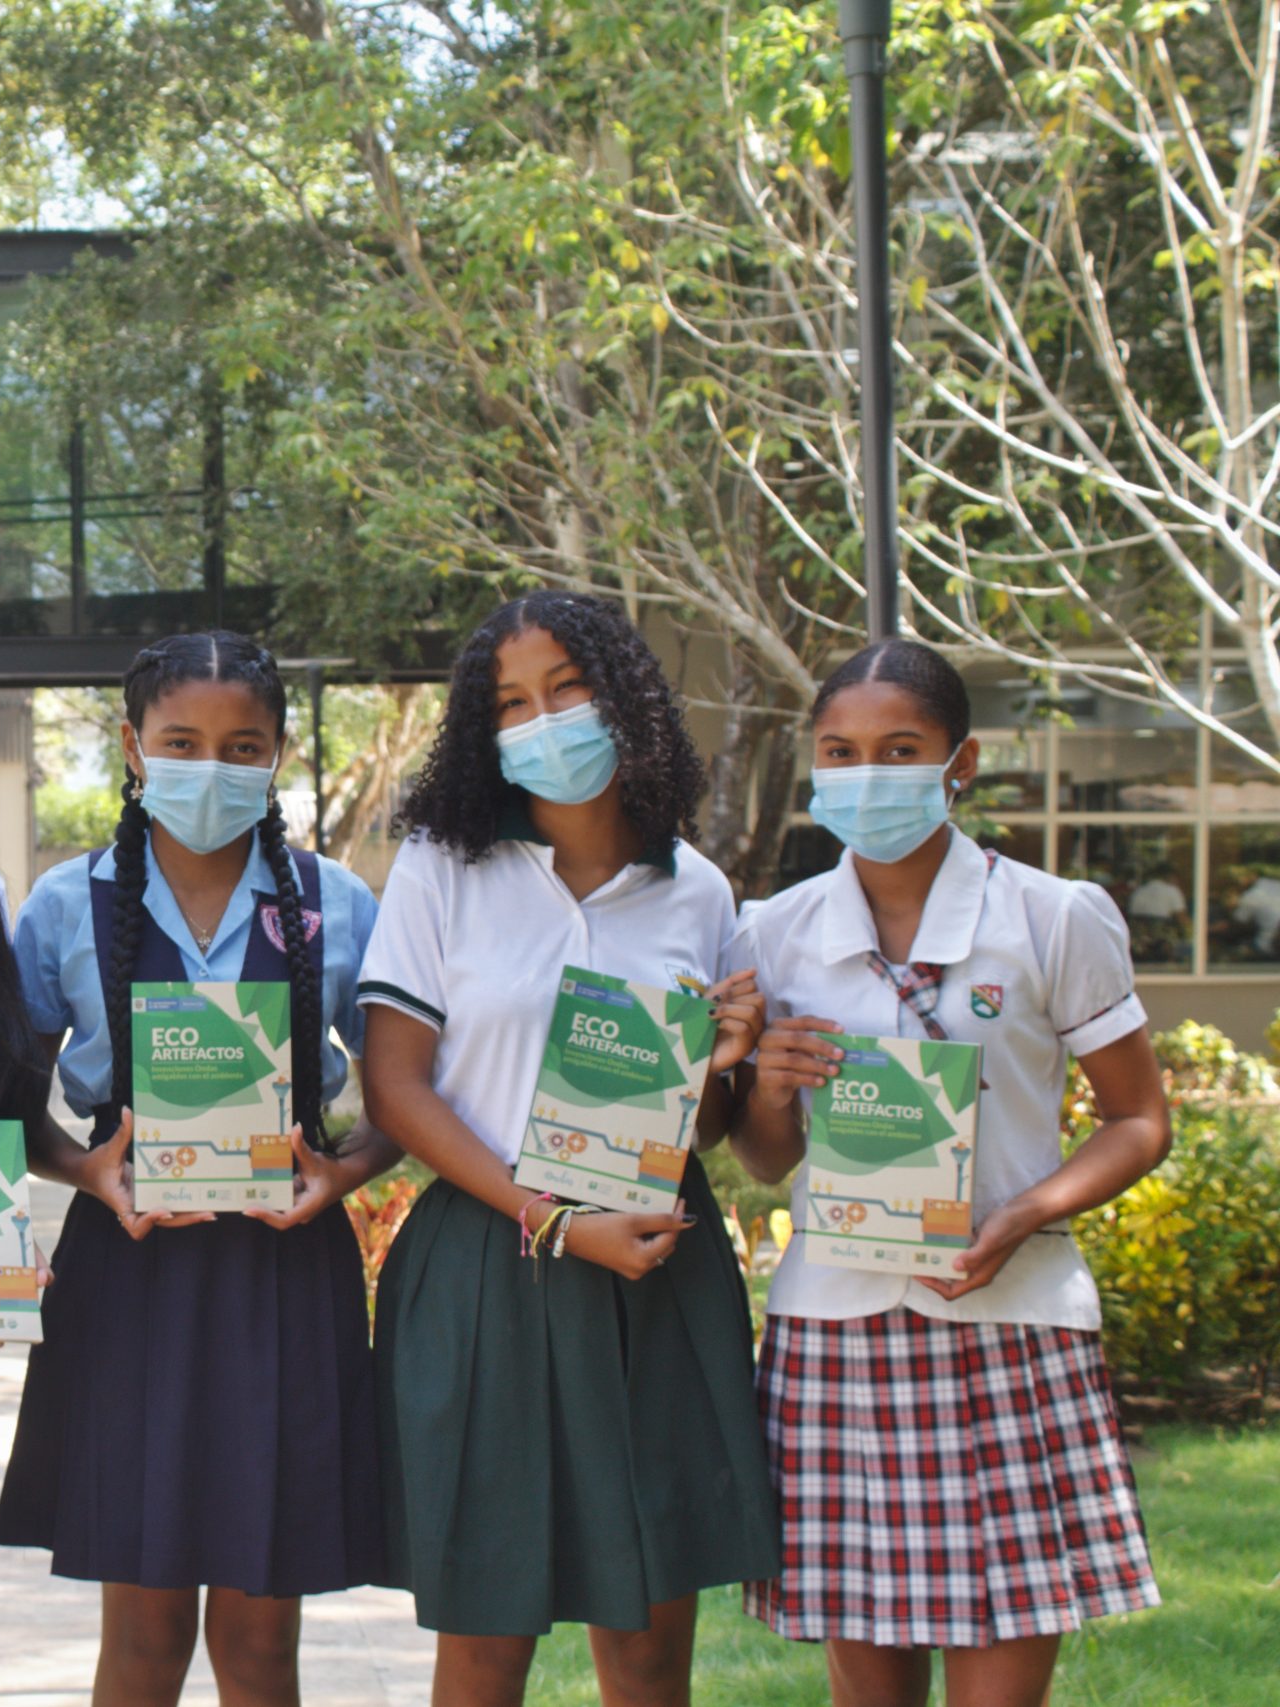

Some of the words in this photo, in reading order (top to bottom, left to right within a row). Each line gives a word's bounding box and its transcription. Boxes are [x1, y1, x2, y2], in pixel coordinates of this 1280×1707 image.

[572, 1012, 620, 1040] ECO
[151, 1027, 199, 1047] ECO
[567, 1031, 660, 1064] ARTEFACTOS
[152, 1046, 244, 1060] ARTEFACTOS
[832, 1080, 880, 1102] ECO
[830, 1100, 924, 1120] ARTEFACTOS
